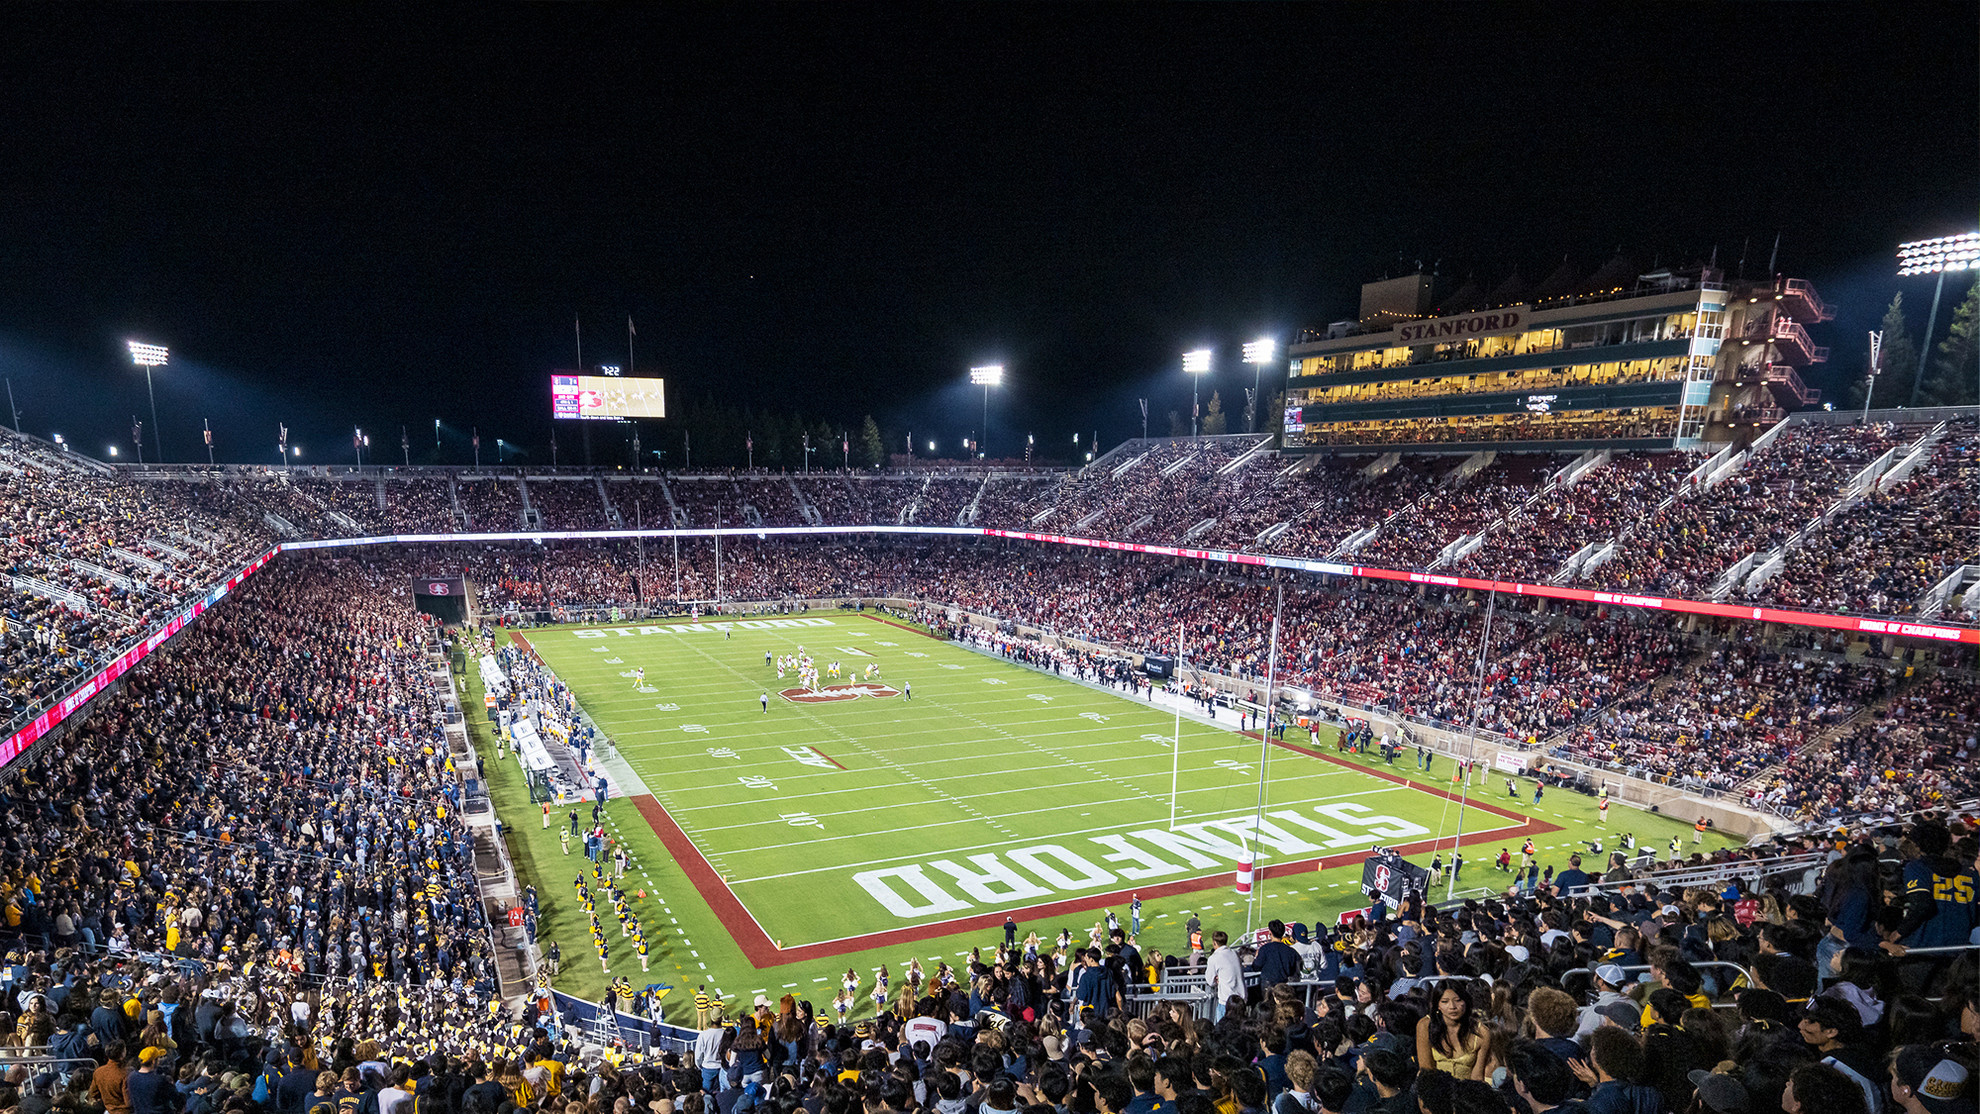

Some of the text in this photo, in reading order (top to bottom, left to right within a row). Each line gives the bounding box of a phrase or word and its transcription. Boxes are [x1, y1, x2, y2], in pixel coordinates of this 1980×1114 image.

[1400, 312, 1520, 342] STANFORD
[602, 366, 620, 376] 7:22
[1594, 592, 1662, 607] HOME OF CHAMPIONS
[572, 617, 836, 639] STANFORD
[1859, 620, 1961, 639] HOME OF CHAMPIONS
[656, 702, 681, 711] 50
[679, 723, 707, 733] 40
[706, 747, 736, 758] 30
[780, 746, 839, 770] ACC
[1213, 759, 1255, 771] 10
[737, 775, 773, 789] 20
[778, 811, 818, 827] 10
[851, 802, 1431, 918] STANFORD
[1933, 873, 1975, 904] 25
[1361, 883, 1399, 911] STFORD
[984, 1013, 1006, 1030] Cal
